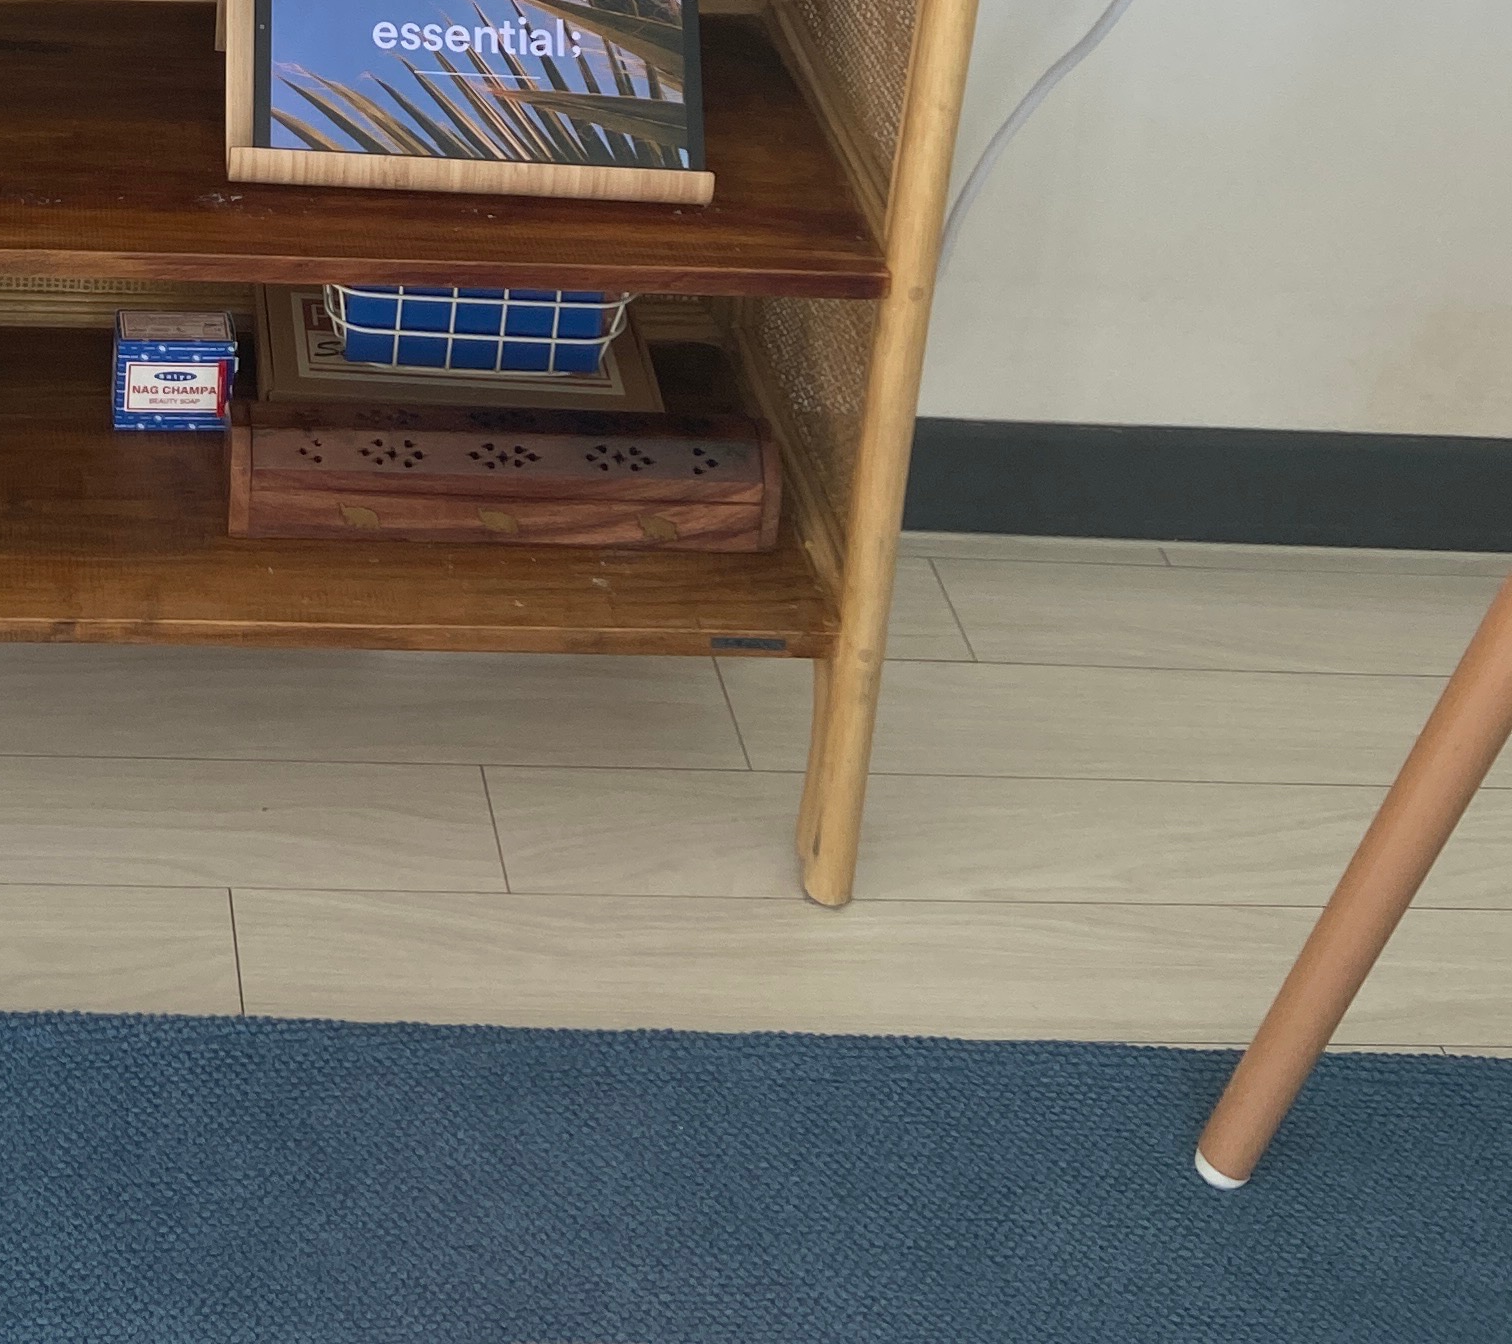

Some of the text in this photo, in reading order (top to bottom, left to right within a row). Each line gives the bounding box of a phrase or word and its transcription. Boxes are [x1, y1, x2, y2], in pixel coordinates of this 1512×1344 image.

[372, 16, 582, 59] essential;
[133, 385, 217, 395] NAG CHAMPA
